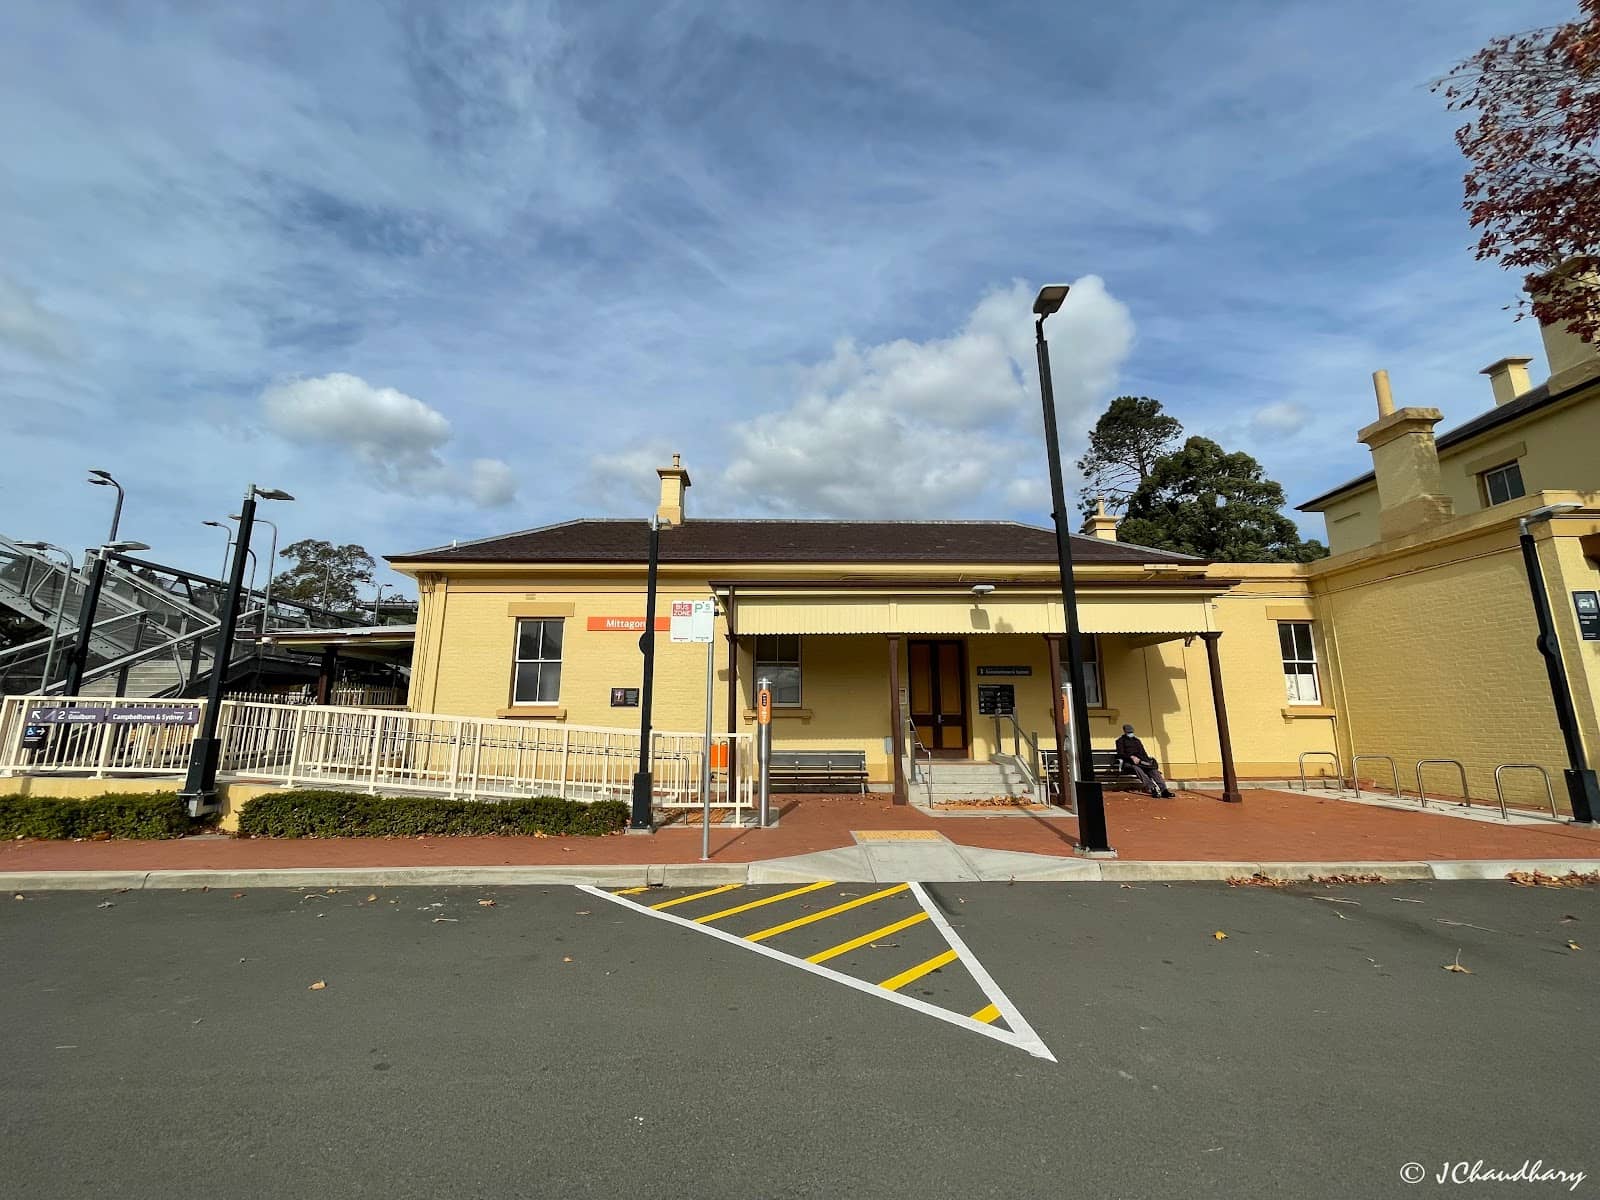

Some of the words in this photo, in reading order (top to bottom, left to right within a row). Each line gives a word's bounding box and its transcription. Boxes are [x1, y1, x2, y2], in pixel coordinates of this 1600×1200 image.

[606, 619, 647, 630] Mittagon
[57, 710, 66, 720] 2
[112, 713, 156, 721] Campbelltown
[161, 713, 184, 721] Sydney
[187, 711, 193, 720] 1
